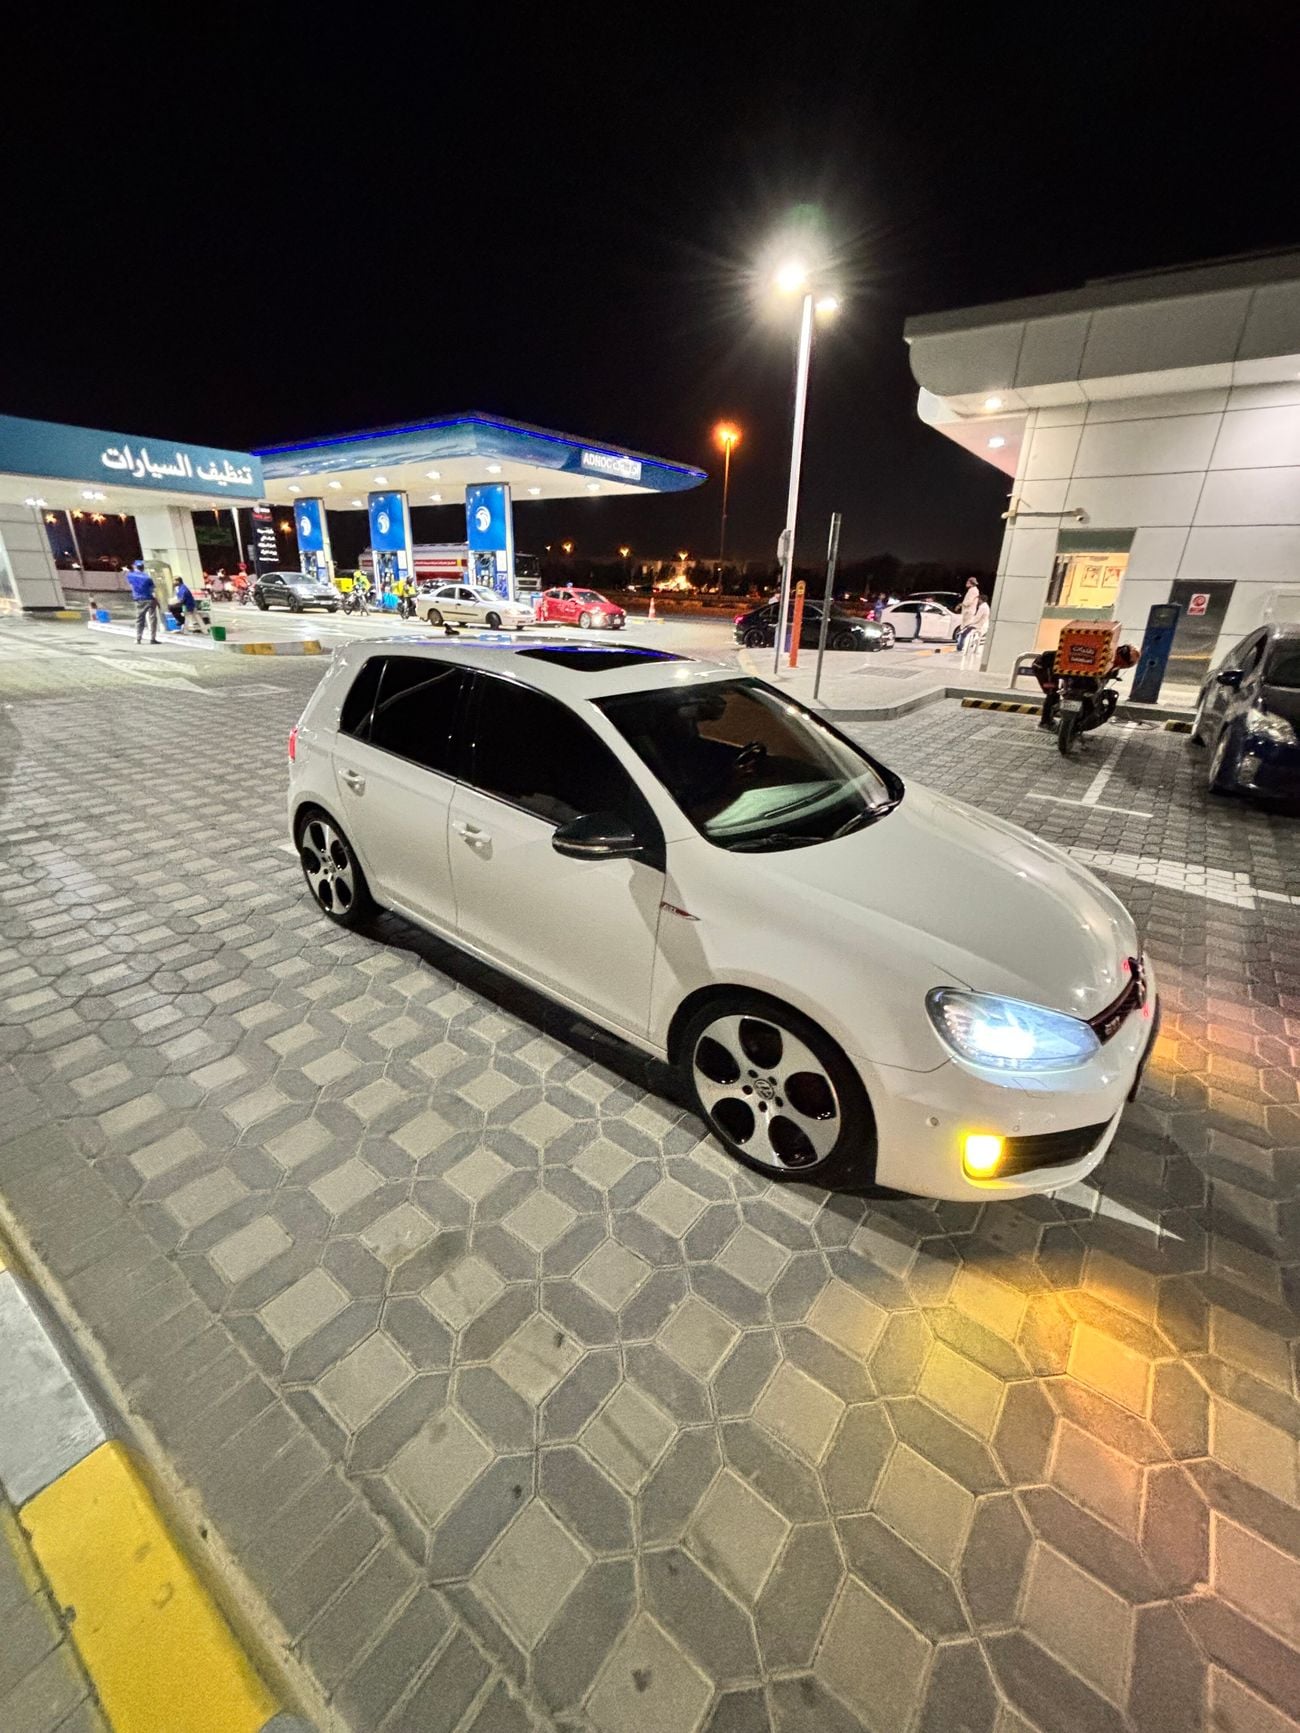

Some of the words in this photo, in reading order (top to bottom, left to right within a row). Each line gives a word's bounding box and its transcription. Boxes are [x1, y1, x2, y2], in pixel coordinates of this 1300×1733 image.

[101, 443, 193, 479] السيارات
[196, 459, 253, 487] تنظيف
[583, 452, 613, 470] ADNOC
